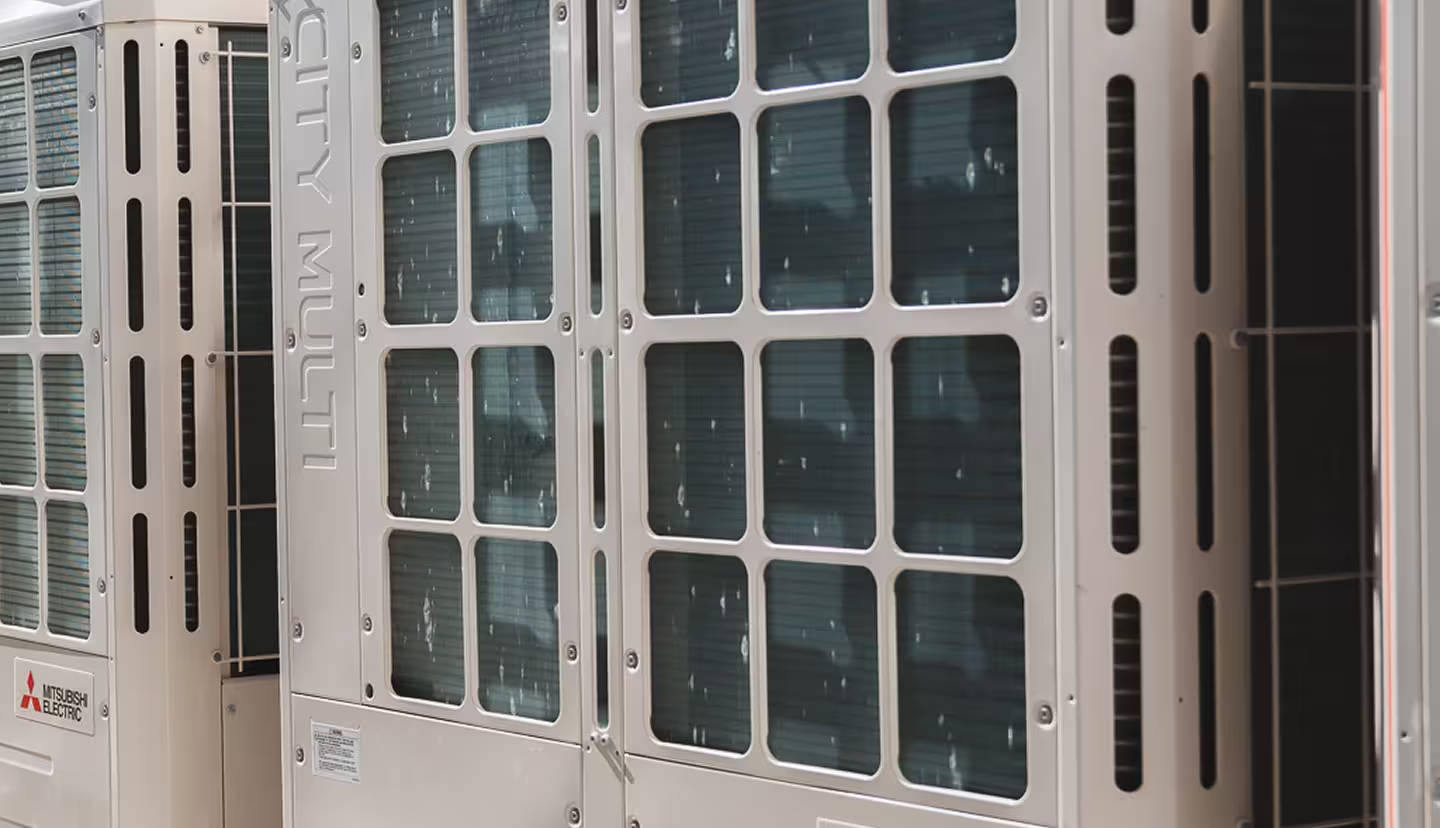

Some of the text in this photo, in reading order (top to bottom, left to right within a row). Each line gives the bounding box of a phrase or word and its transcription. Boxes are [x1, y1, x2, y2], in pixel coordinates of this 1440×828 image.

[295, 8, 337, 470] CITY MULTI
[42, 683, 88, 708] MITSUBISHI
[42, 699, 83, 722] ELECTRIC
